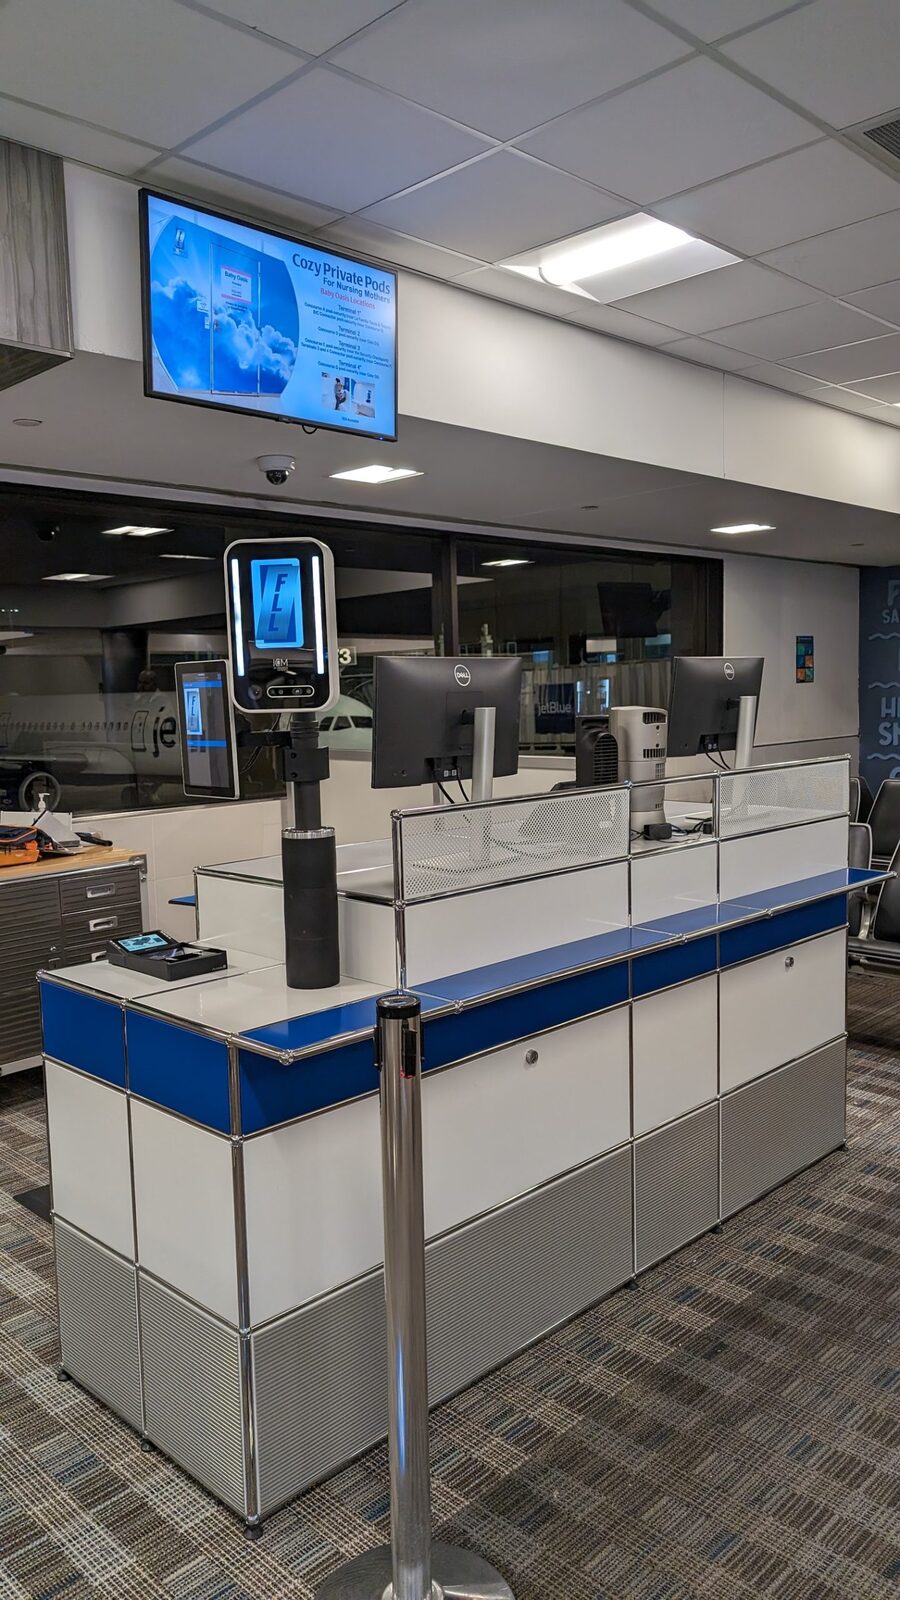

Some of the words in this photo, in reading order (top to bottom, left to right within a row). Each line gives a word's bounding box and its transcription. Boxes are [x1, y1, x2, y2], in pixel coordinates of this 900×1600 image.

[292, 253, 321, 277] Cozy
[323, 262, 363, 286] Private
[365, 275, 390, 295] Pods
[323, 277, 335, 287] For
[337, 281, 363, 297] Nursing
[365, 290, 390, 303] Mothers
[321, 288, 334, 299] Baby
[335, 292, 349, 303] Oasis
[350, 297, 375, 309] Locations
[338, 305, 356, 314] Terminal
[338, 325, 356, 335] Terminal
[339, 341, 356, 350] Terminal
[339, 360, 356, 369] Terminal
[268, 573, 289, 632] FLL
[338, 648, 352, 664] 3
[538, 700, 572, 716] jetBlue
[153, 706, 176, 758] je
